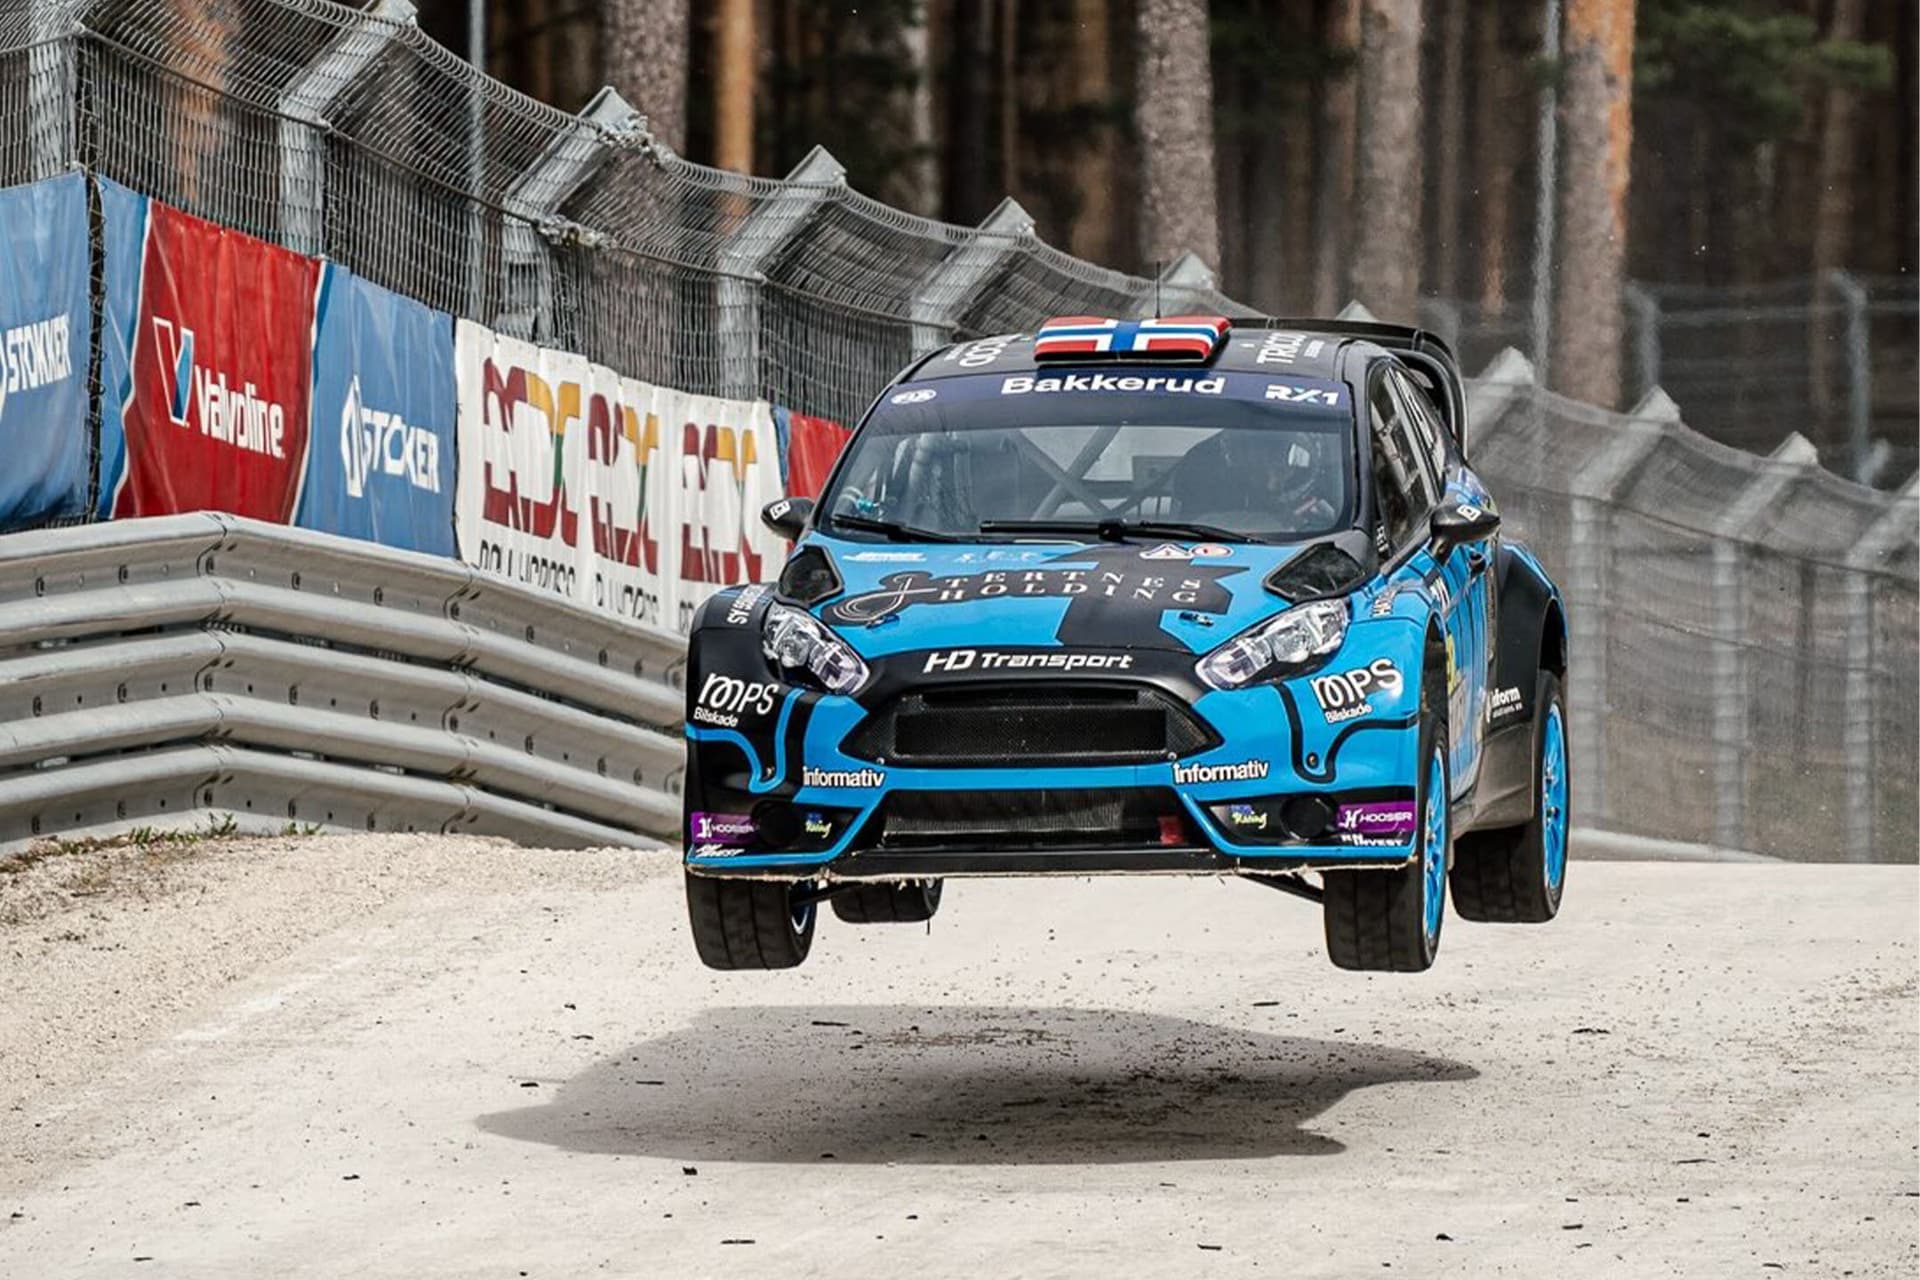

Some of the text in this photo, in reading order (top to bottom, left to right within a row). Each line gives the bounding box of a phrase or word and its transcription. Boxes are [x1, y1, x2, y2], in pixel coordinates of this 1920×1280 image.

[1001, 374, 1225, 395] Bakkerud
[1265, 384, 1339, 406] RX1
[194, 364, 284, 459] Valvoline
[939, 583, 1199, 603] HOLDING
[923, 650, 1133, 673] HD Transport
[693, 706, 739, 728] Bilskade
[1325, 703, 1372, 723] Bilskade
[802, 765, 885, 786] informativ
